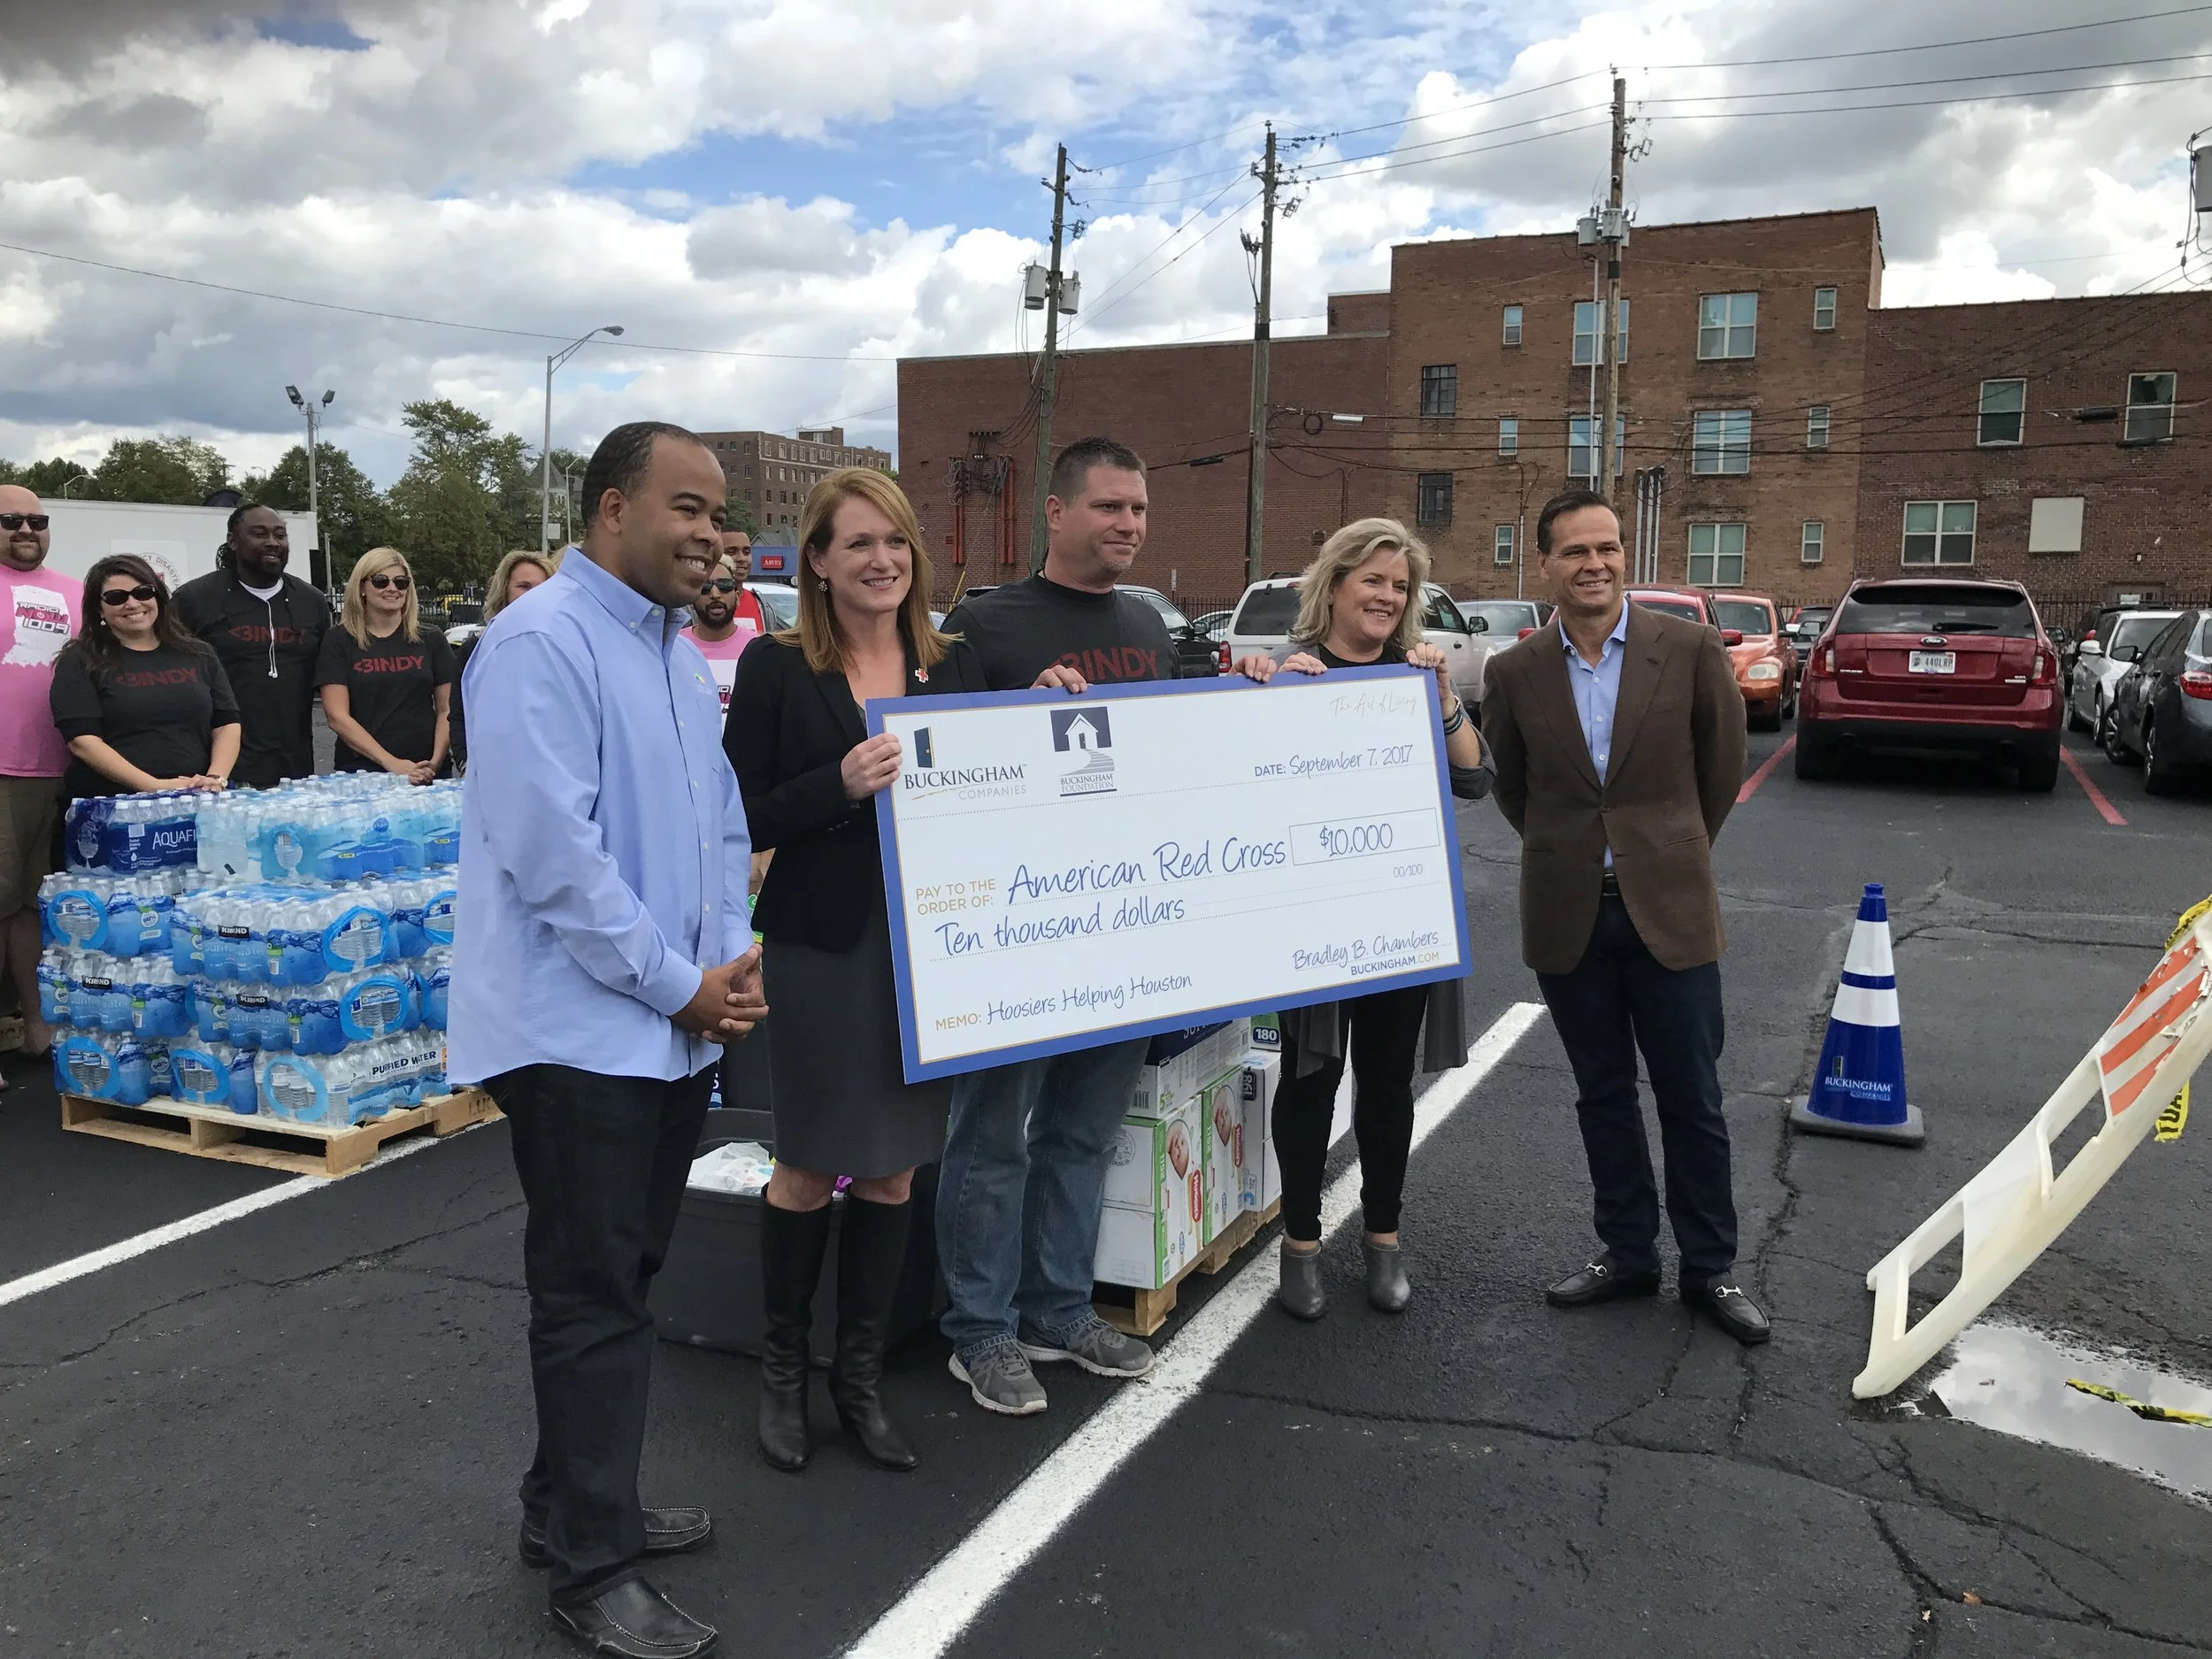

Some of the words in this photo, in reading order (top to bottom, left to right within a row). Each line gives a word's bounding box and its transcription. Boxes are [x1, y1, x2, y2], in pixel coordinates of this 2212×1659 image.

[17, 601, 60, 613] RADIO
[353, 655, 424, 673] <3INDY
[1255, 764, 1286, 777] DATE:
[1289, 751, 1363, 780] September
[1367, 748, 1379, 766] 7,
[1381, 744, 1413, 766] 2017
[1061, 773, 1113, 786] BUCKINGHAM
[1062, 781, 1114, 793] FOUNDATION
[958, 784, 1026, 800] COMPANIES
[1319, 823, 1393, 857] $10,000
[1008, 859, 1147, 905] American
[1153, 839, 1213, 881] Red
[1222, 837, 1286, 873] Cross
[916, 885, 941, 900] PAY
[946, 882, 965, 897] TO
[969, 878, 996, 893] THE
[918, 897, 967, 916] ORDER
[971, 894, 994, 908] OF:
[934, 922, 984, 956] Ten
[994, 901, 1102, 947] thousand
[1112, 895, 1186, 930] dollars
[1293, 944, 1348, 970] Bradley
[1352, 939, 1370, 959] B.
[1373, 931, 1440, 956] Chambers
[1351, 951, 1440, 975] BUCKINGHAM.COM
[935, 1013, 982, 1031] MEMO:
[987, 996, 1056, 1025] Hoosiers
[1062, 985, 1125, 1012] Helping
[1130, 973, 1193, 1000] Houston
[1256, 1028, 1278, 1041] 180
[1824, 1076, 1891, 1092] BUCKINGHAM
